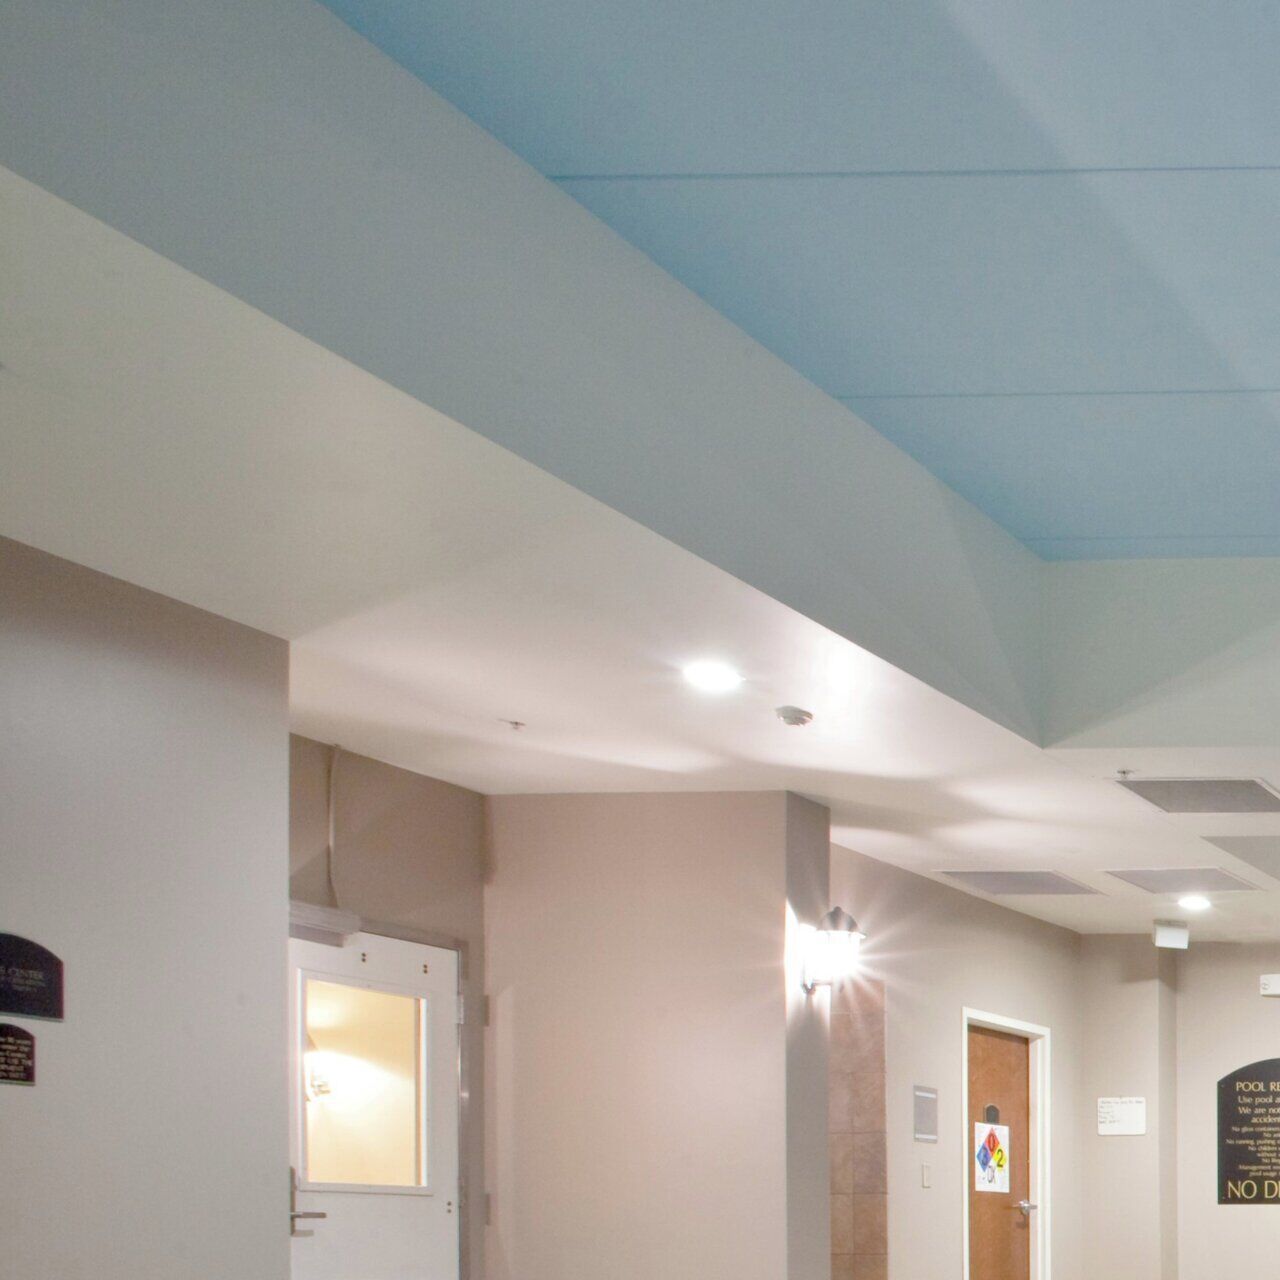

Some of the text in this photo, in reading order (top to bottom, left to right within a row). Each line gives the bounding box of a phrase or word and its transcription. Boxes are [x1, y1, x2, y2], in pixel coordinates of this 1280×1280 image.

[1236, 1081, 1265, 1092] POOL
[1238, 1095, 1252, 1103] Use
[1255, 1095, 1273, 1105] pool
[1238, 1106, 1251, 1114] We
[1269, 1106, 1280, 1114] not
[996, 1148, 1004, 1168] 2
[1228, 1180, 1257, 1199] NO
